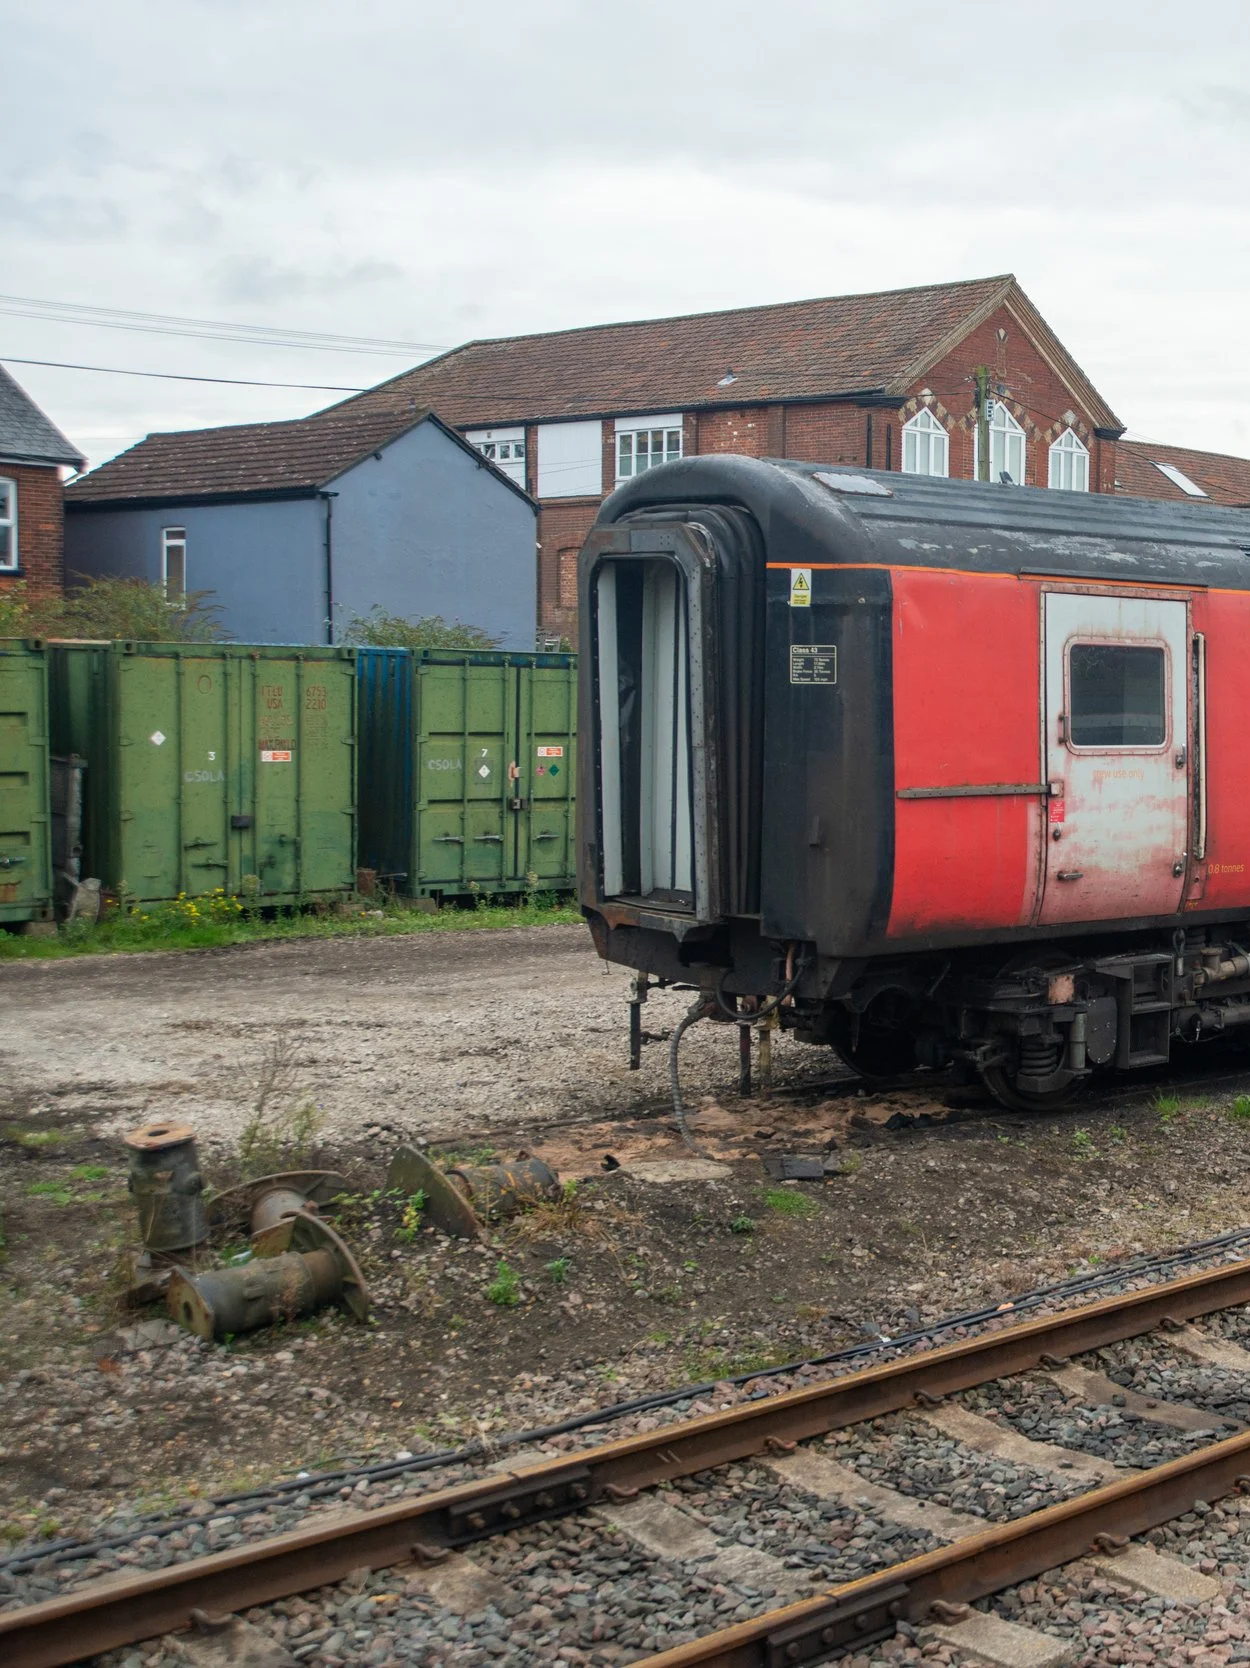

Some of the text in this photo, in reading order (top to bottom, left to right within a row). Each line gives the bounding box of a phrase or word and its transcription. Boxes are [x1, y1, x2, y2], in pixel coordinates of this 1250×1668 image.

[267, 698, 283, 709] USA
[208, 751, 216, 761] 3
[481, 748, 489, 758] 7
[1112, 769, 1127, 778] use
[1128, 767, 1145, 781] only
[1208, 863, 1245, 874] 0.8 tonnes
